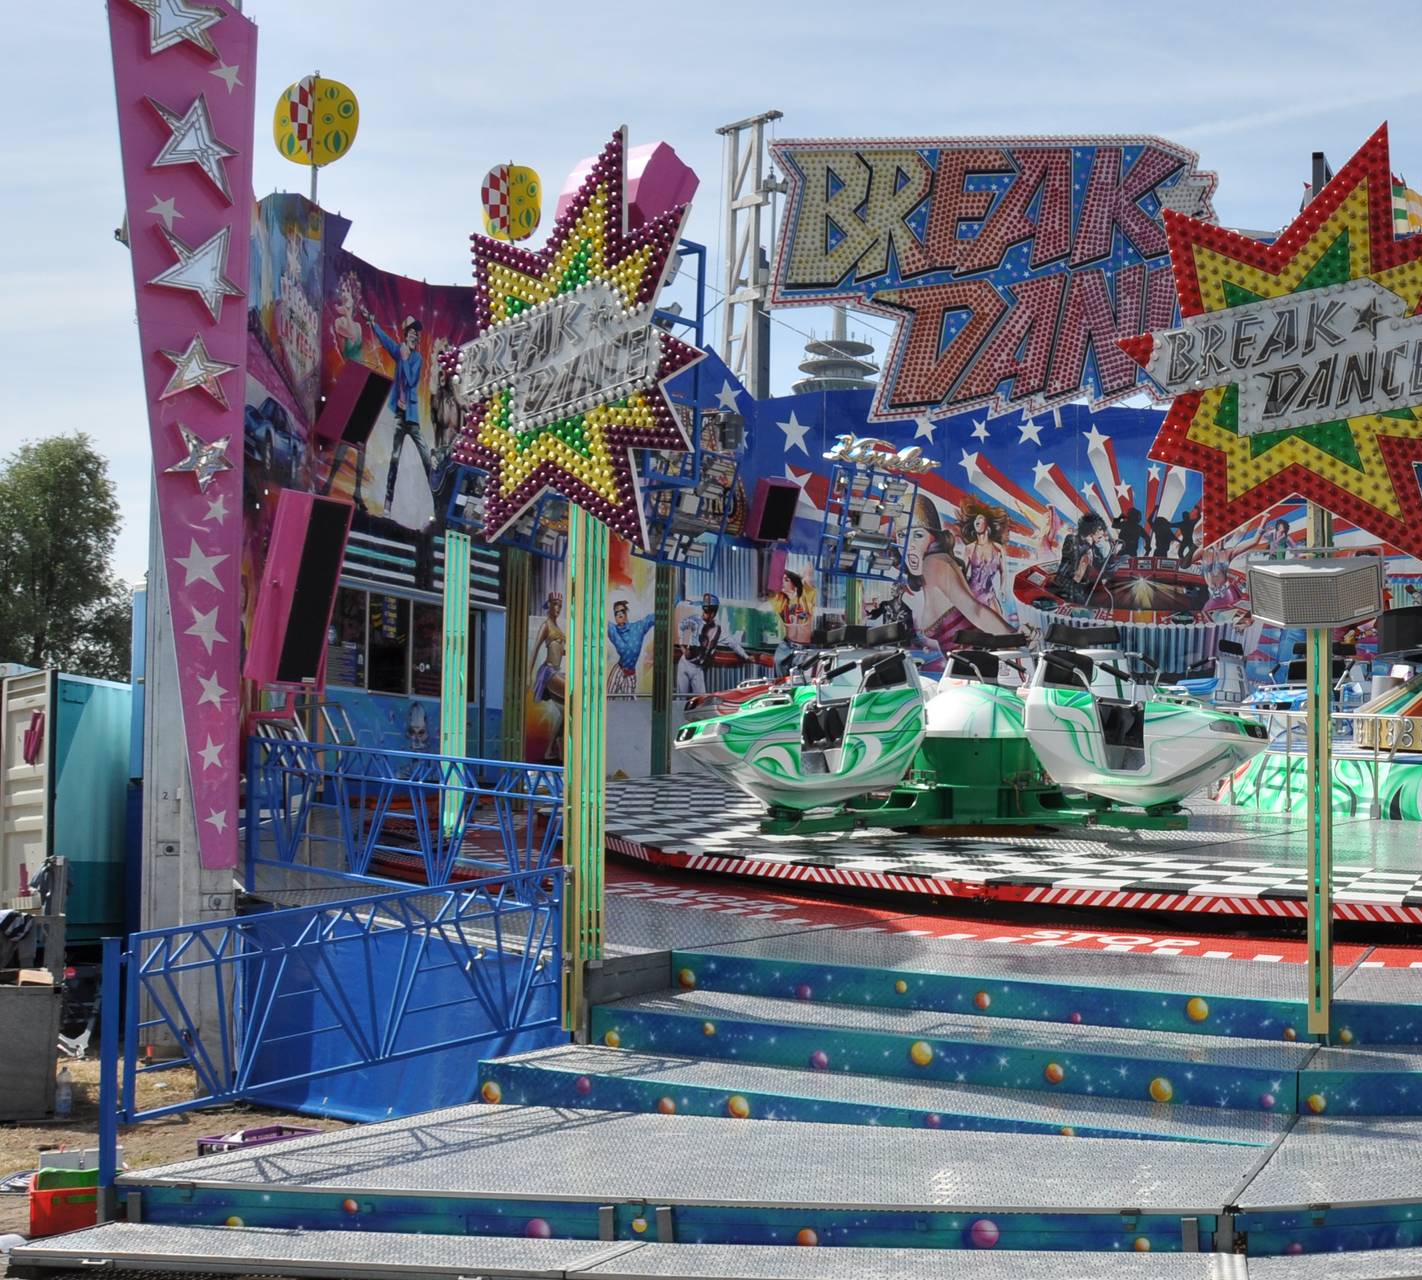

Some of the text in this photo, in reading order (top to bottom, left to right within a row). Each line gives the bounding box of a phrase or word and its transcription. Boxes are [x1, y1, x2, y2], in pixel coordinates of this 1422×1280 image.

[784, 148, 1186, 289] BREAK
[463, 300, 584, 393] BREAK
[521, 324, 650, 415] DANCE
[872, 263, 1178, 409] DAN
[1164, 301, 1346, 386] BREAK
[606, 881, 799, 912] DANGER
[1022, 930, 1201, 947] STOP
